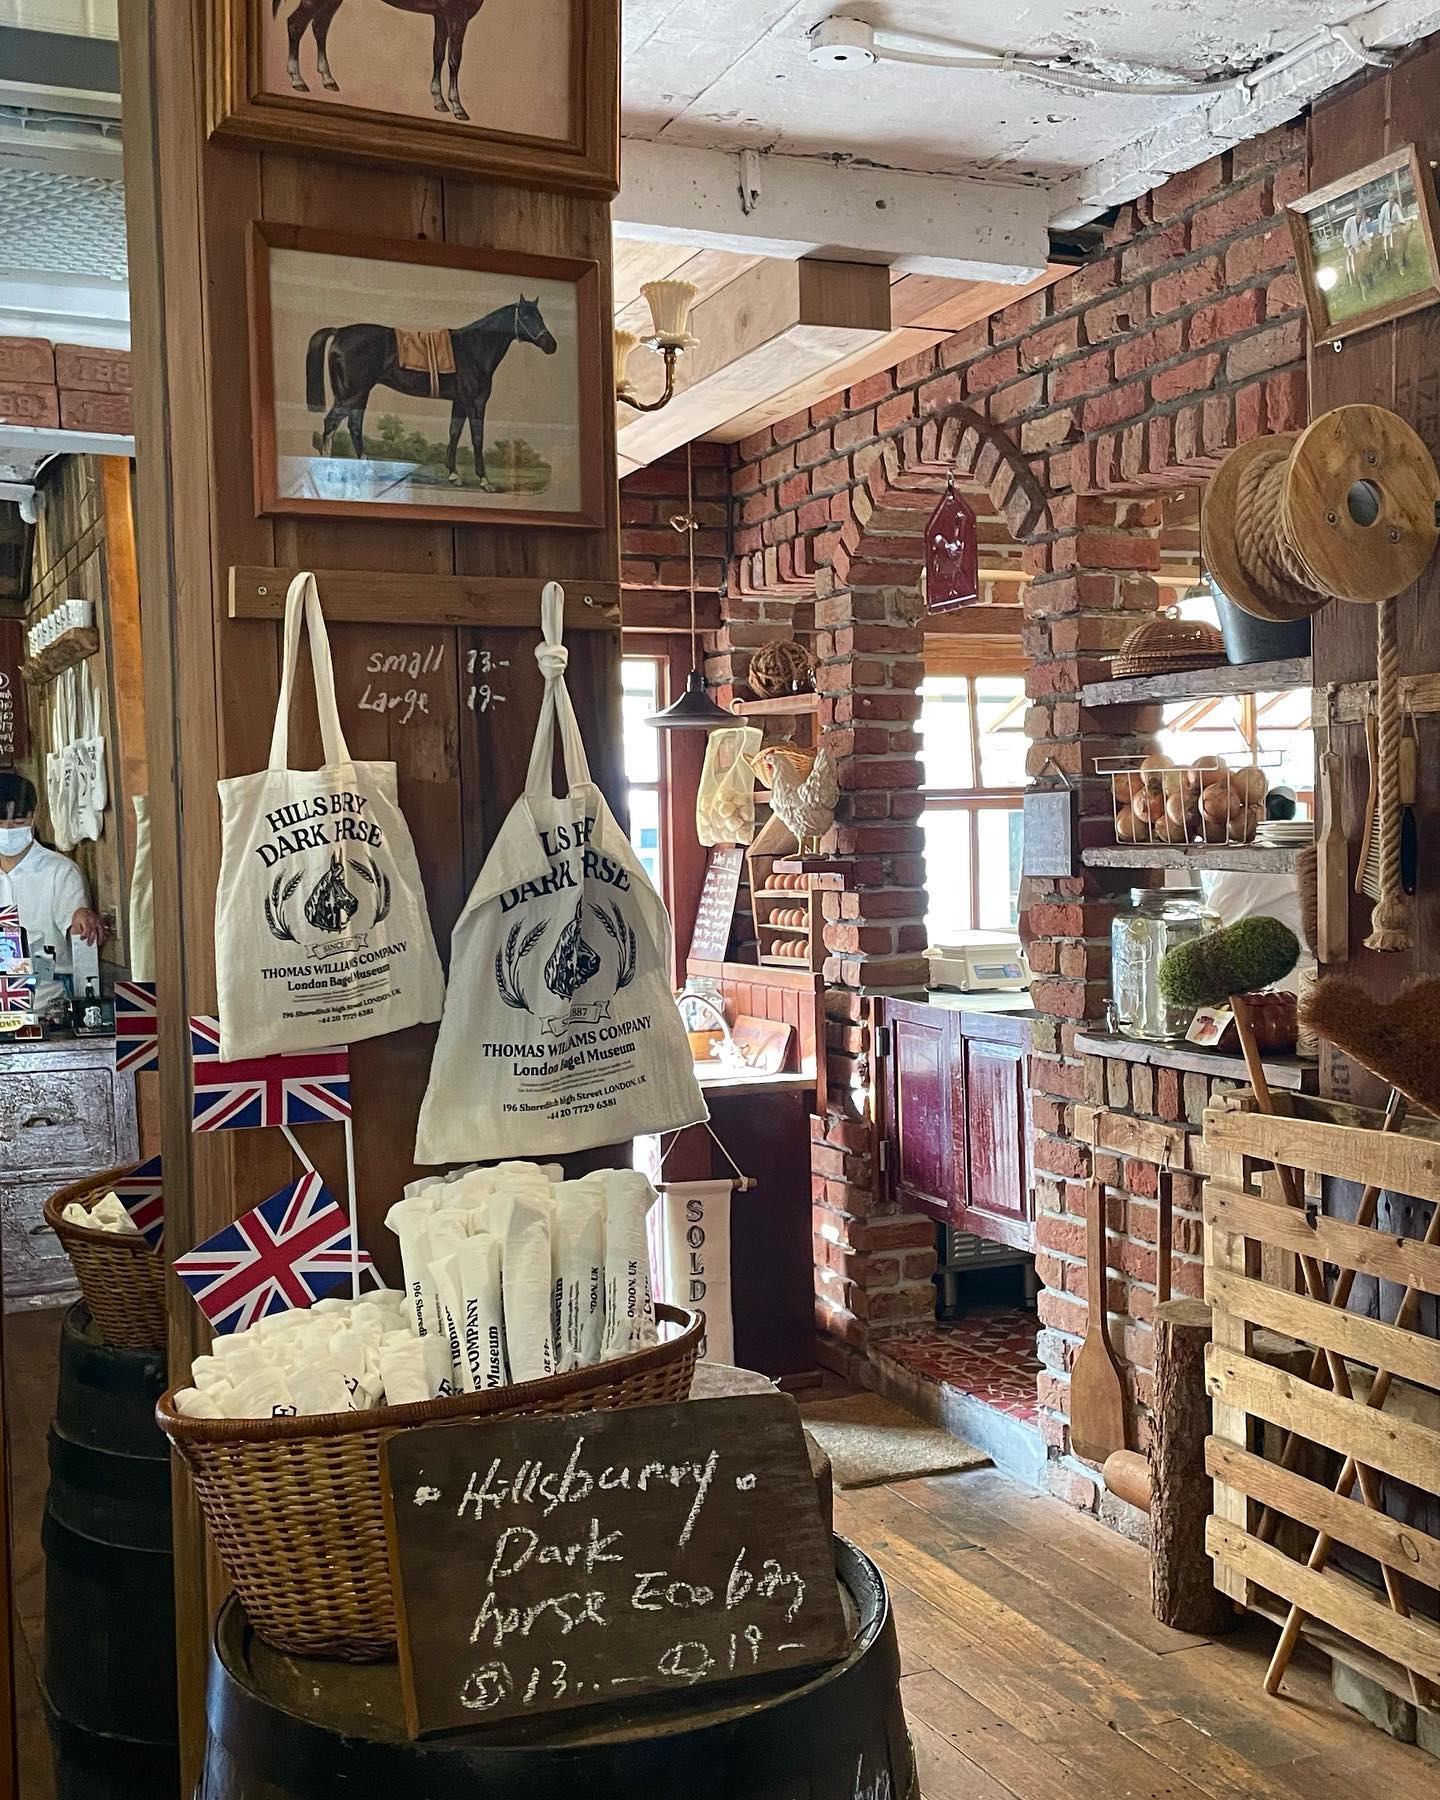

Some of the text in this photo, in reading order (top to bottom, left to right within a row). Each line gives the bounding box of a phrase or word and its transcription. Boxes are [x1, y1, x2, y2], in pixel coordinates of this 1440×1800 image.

[358, 684, 429, 724] Large
[256, 823, 331, 868] DARK
[499, 860, 577, 913] DARK
[261, 966, 312, 979] THOMAS
[313, 957, 358, 975] WILLIAS
[359, 941, 407, 965] COMPANY
[287, 979, 328, 991] London
[482, 1043, 545, 1058] THOMAS
[599, 1015, 651, 1042] COMPANY
[586, 1042, 636, 1063] Museum
[503, 1103, 518, 1112] 196
[576, 1089, 603, 1101] Street
[560, 1108, 571, 1118] 20
[572, 1103, 595, 1115] 7729
[597, 1097, 617, 1110] 6381
[628, 1261, 638, 1276] UK
[686, 1199, 707, 1303] SOLD
[412, 1281, 422, 1298] 196
[590, 1266, 600, 1281] UK
[466, 1298, 481, 1373] COMPANY
[487, 1325, 500, 1388] Museum
[543, 1359, 552, 1373] 20
[457, 1436, 720, 1549] Hillsburry
[486, 1517, 624, 1587] Dark
